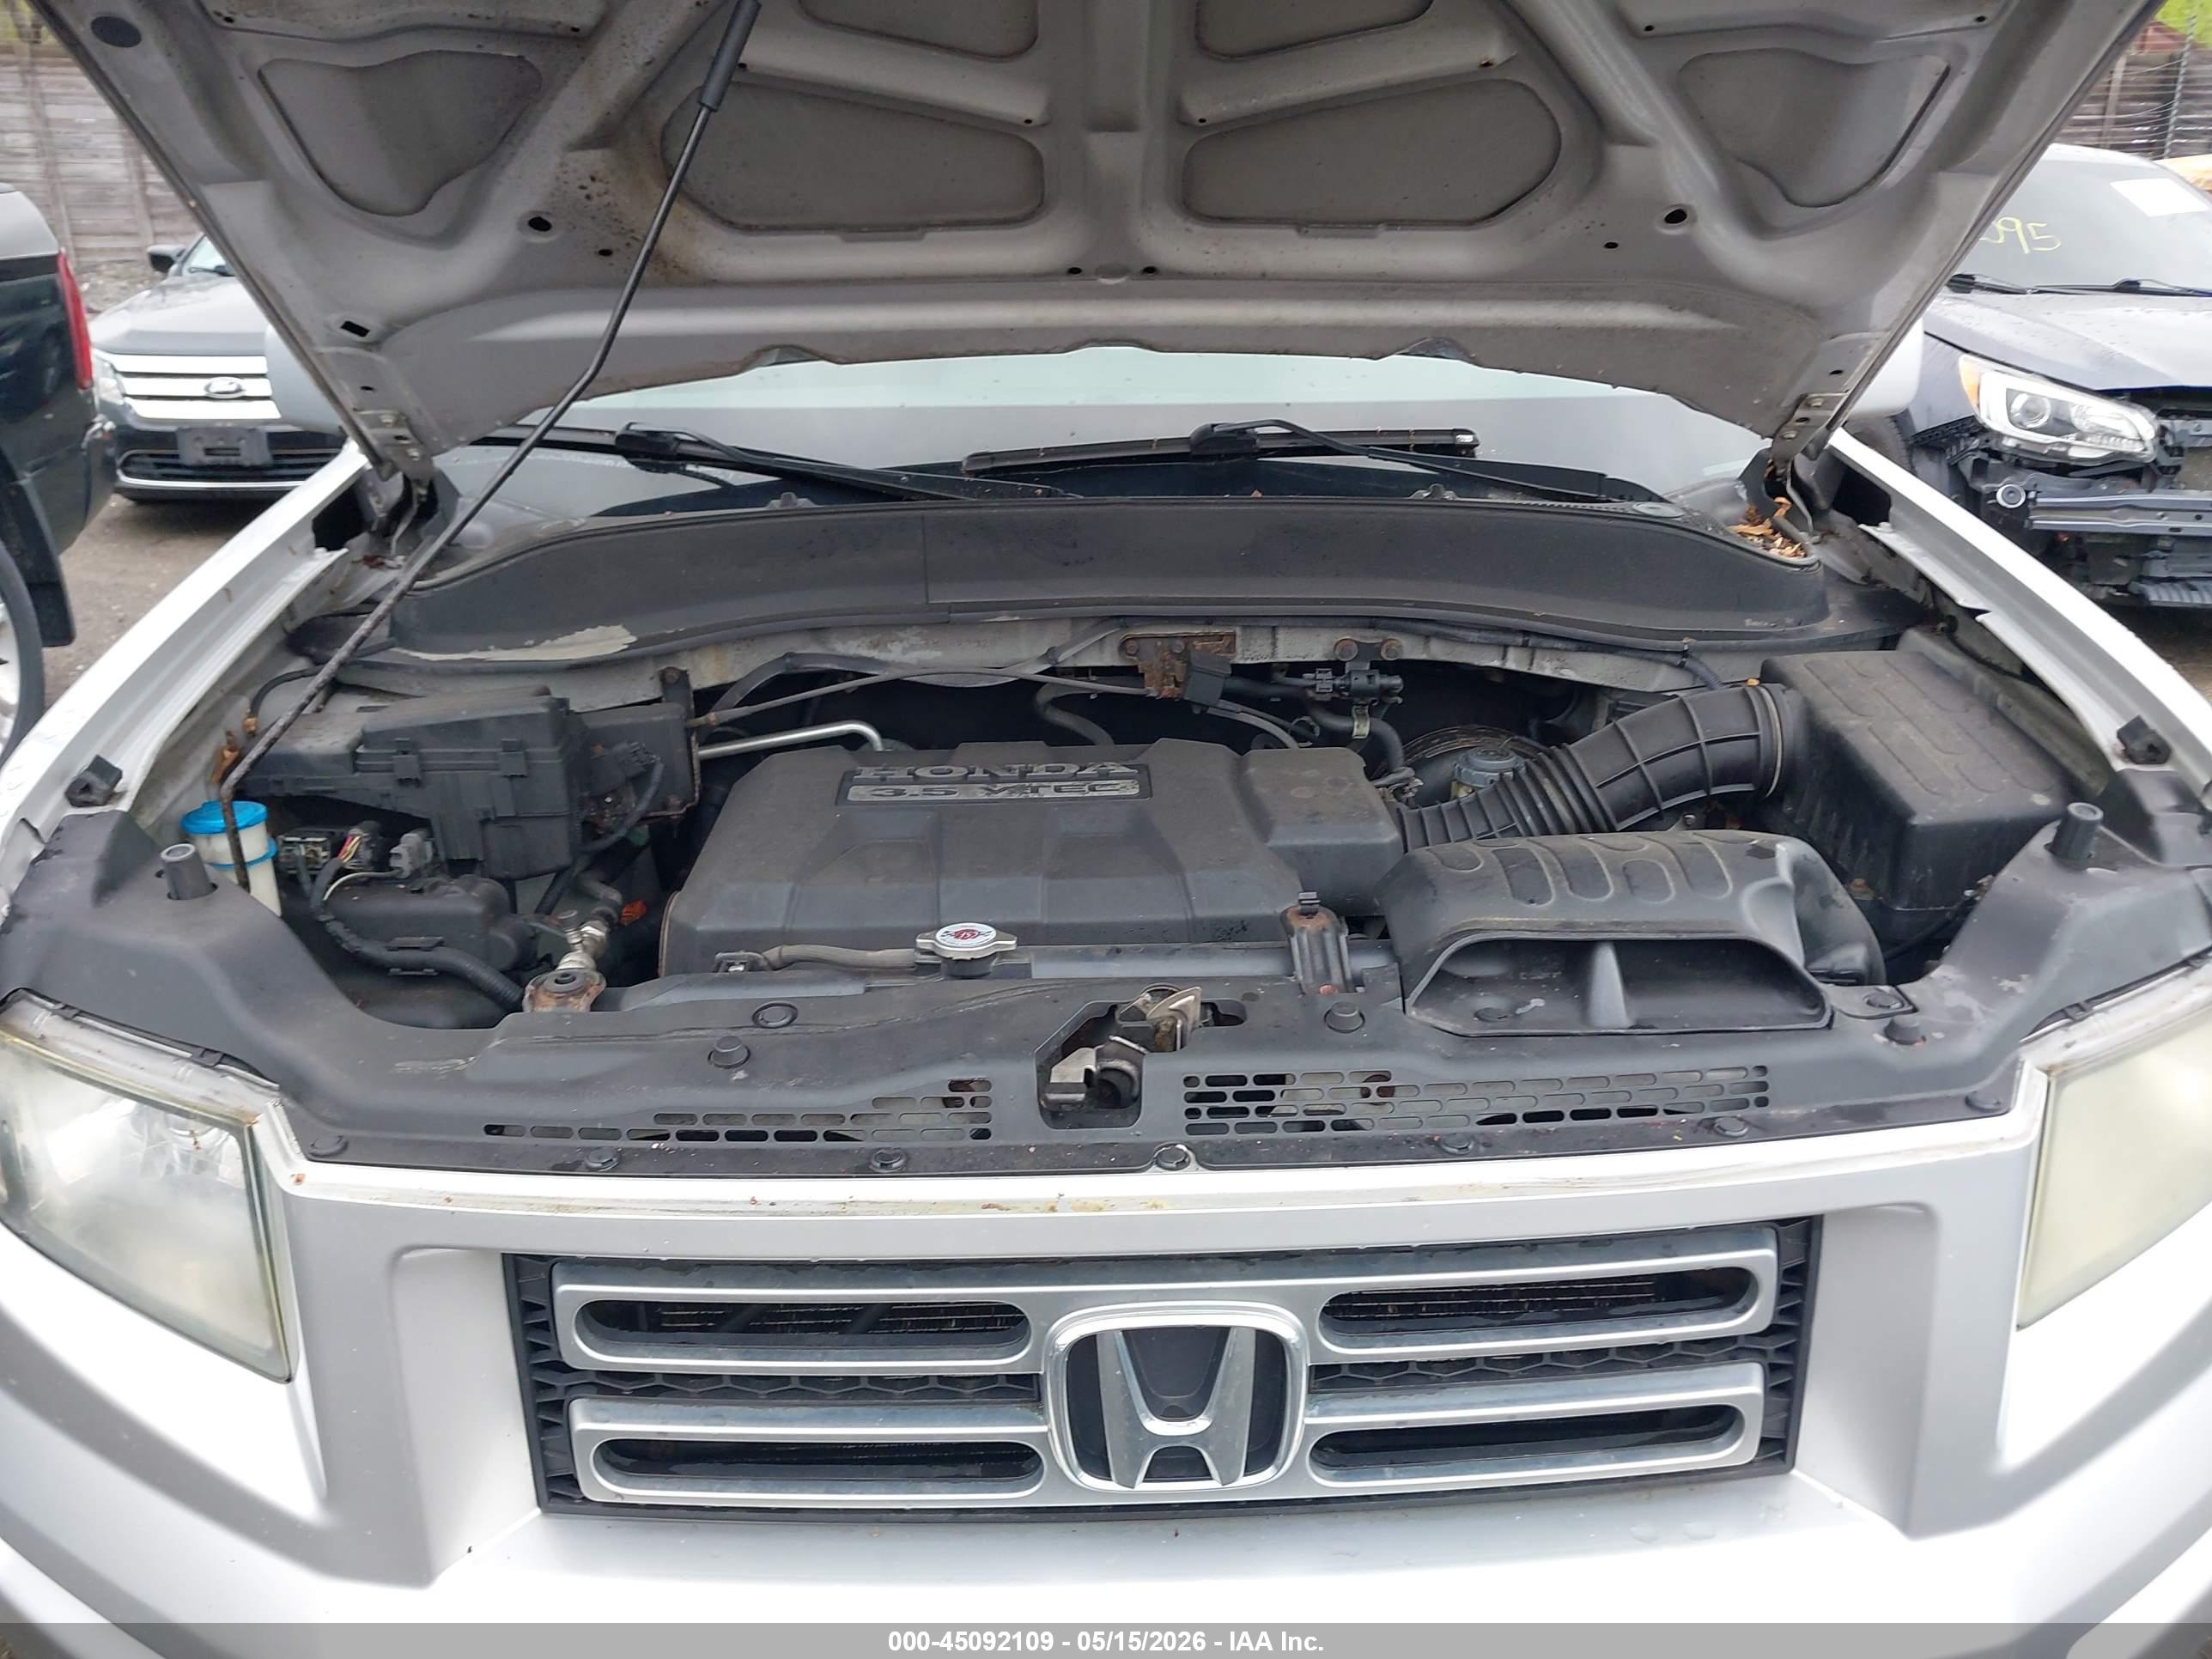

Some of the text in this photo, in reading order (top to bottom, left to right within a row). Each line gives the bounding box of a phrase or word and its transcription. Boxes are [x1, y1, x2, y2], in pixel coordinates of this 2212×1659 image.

[853, 762, 1139, 779] HONDA
[869, 782, 1121, 799] 3.5 VTEC
